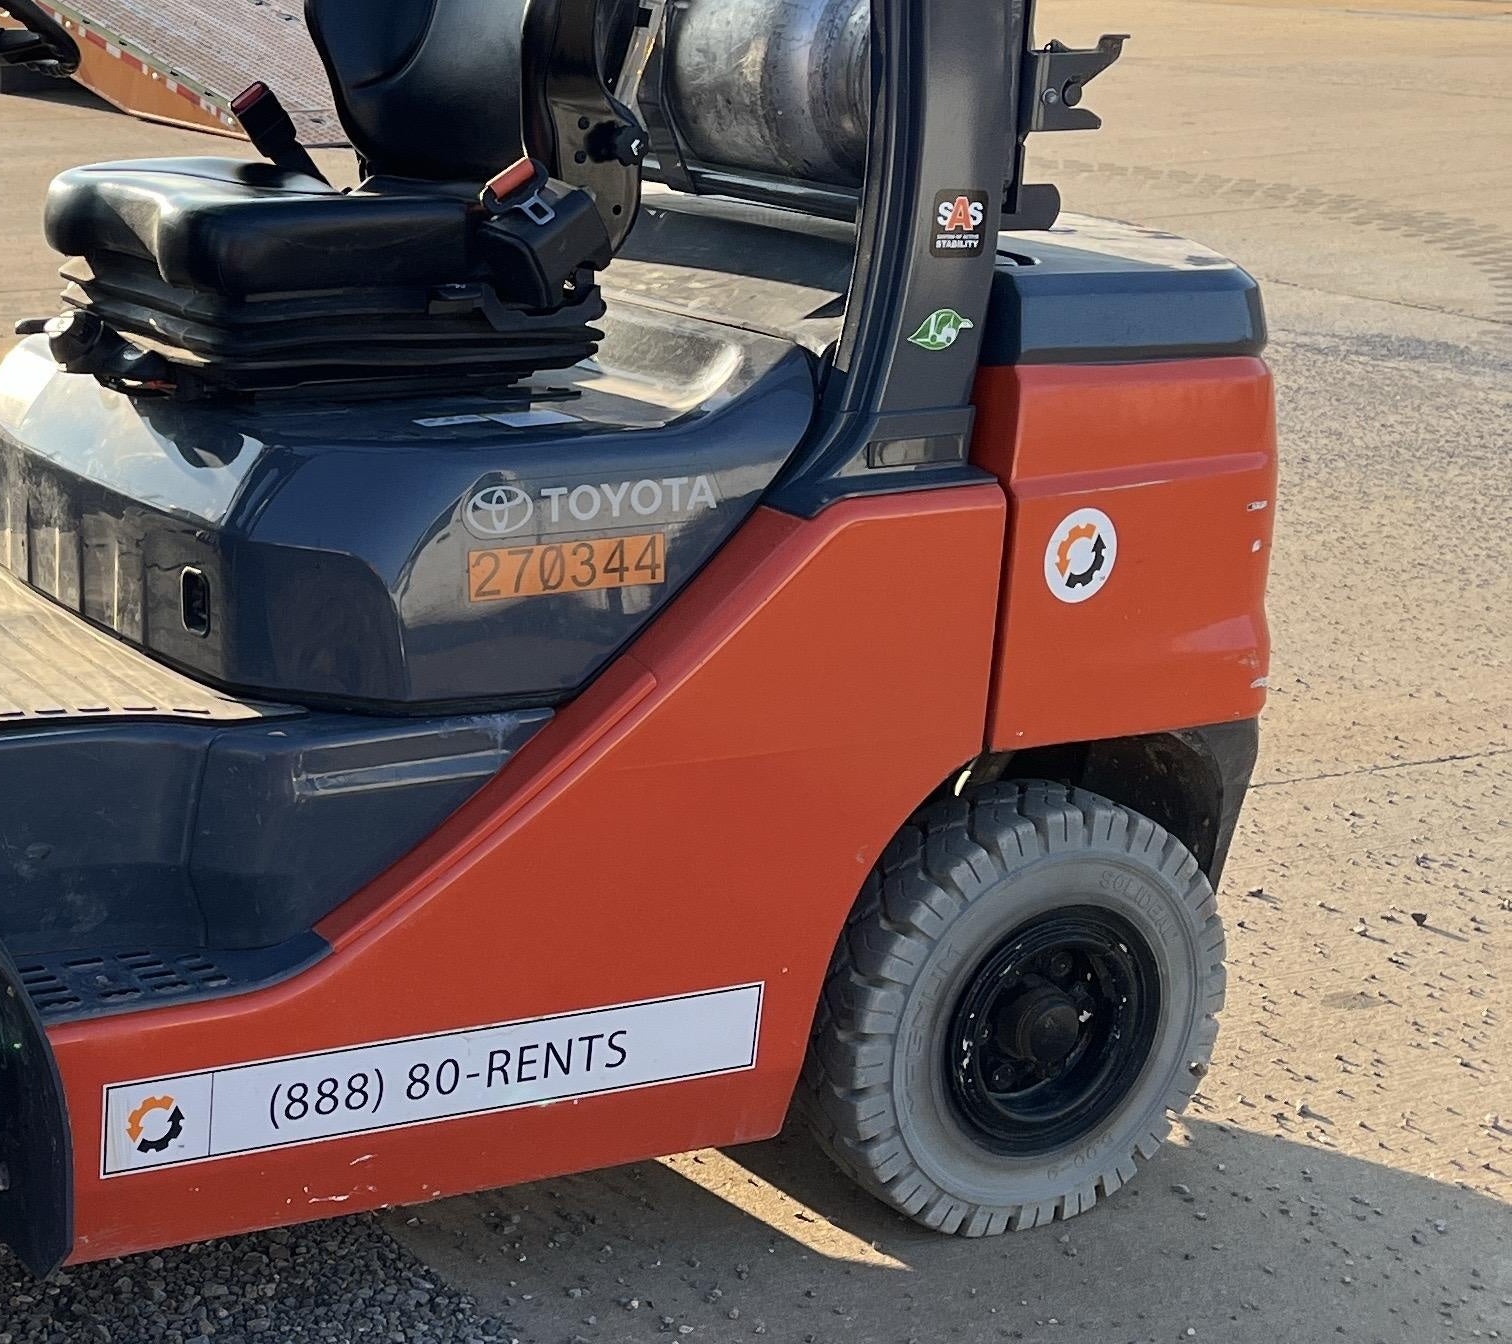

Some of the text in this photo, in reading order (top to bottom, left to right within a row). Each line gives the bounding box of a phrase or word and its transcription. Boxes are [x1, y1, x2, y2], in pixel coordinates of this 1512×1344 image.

[937, 196, 984, 231] SAS
[935, 240, 979, 248] STABILITY
[540, 475, 718, 522] TOYOTA
[472, 536, 661, 598] 270344
[268, 1029, 629, 1130] (888) 80-RENTS
